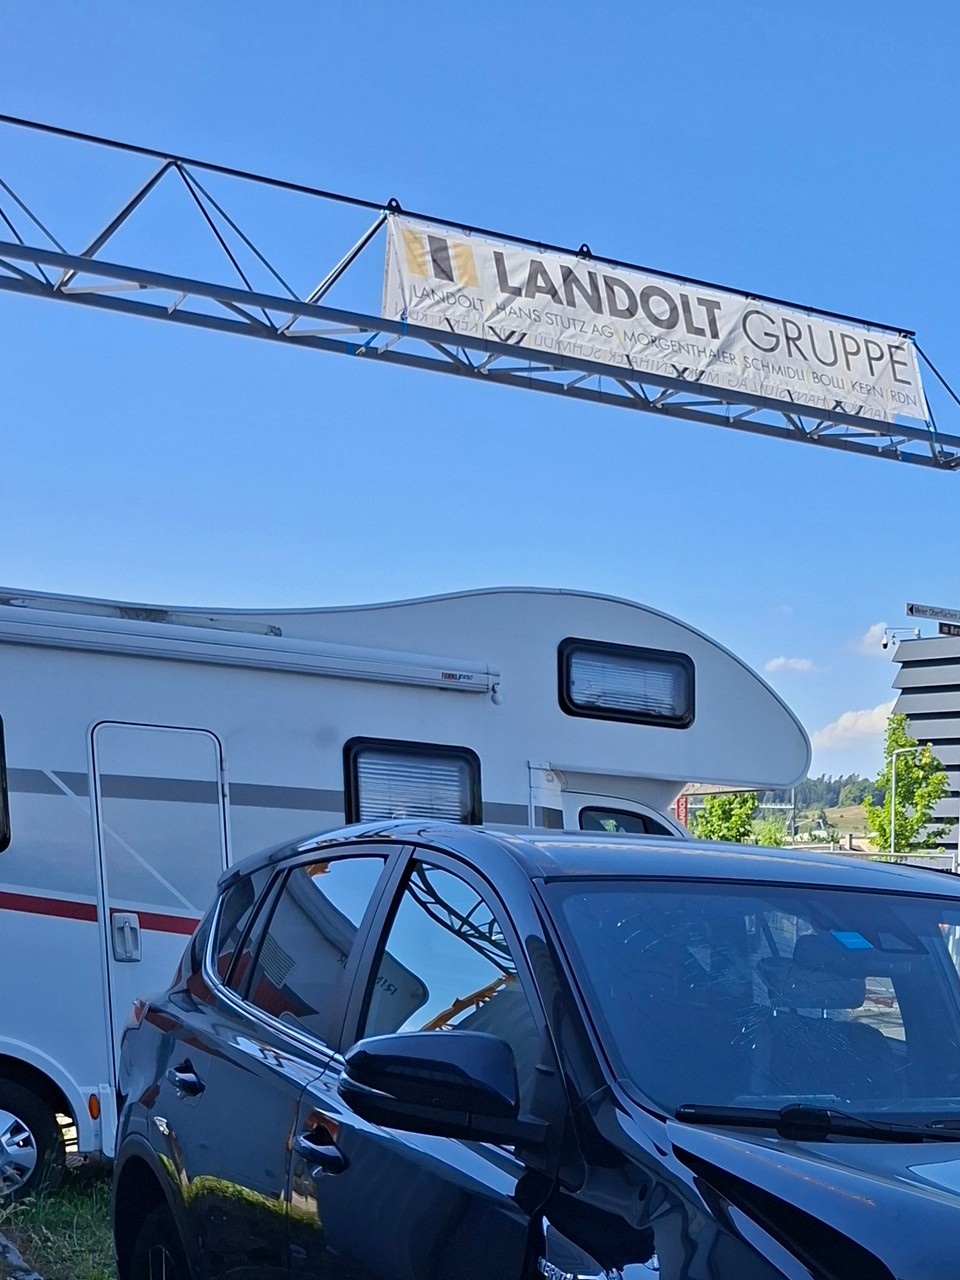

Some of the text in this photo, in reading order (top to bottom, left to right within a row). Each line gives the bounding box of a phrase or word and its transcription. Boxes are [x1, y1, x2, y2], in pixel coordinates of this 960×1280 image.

[412, 284, 917, 406] LANDOLT HANS STUTZ AG MORGENTHALER SCHMIDLI BOLLI KERN RDN
[493, 251, 912, 386] LANDOLT GRUPPE
